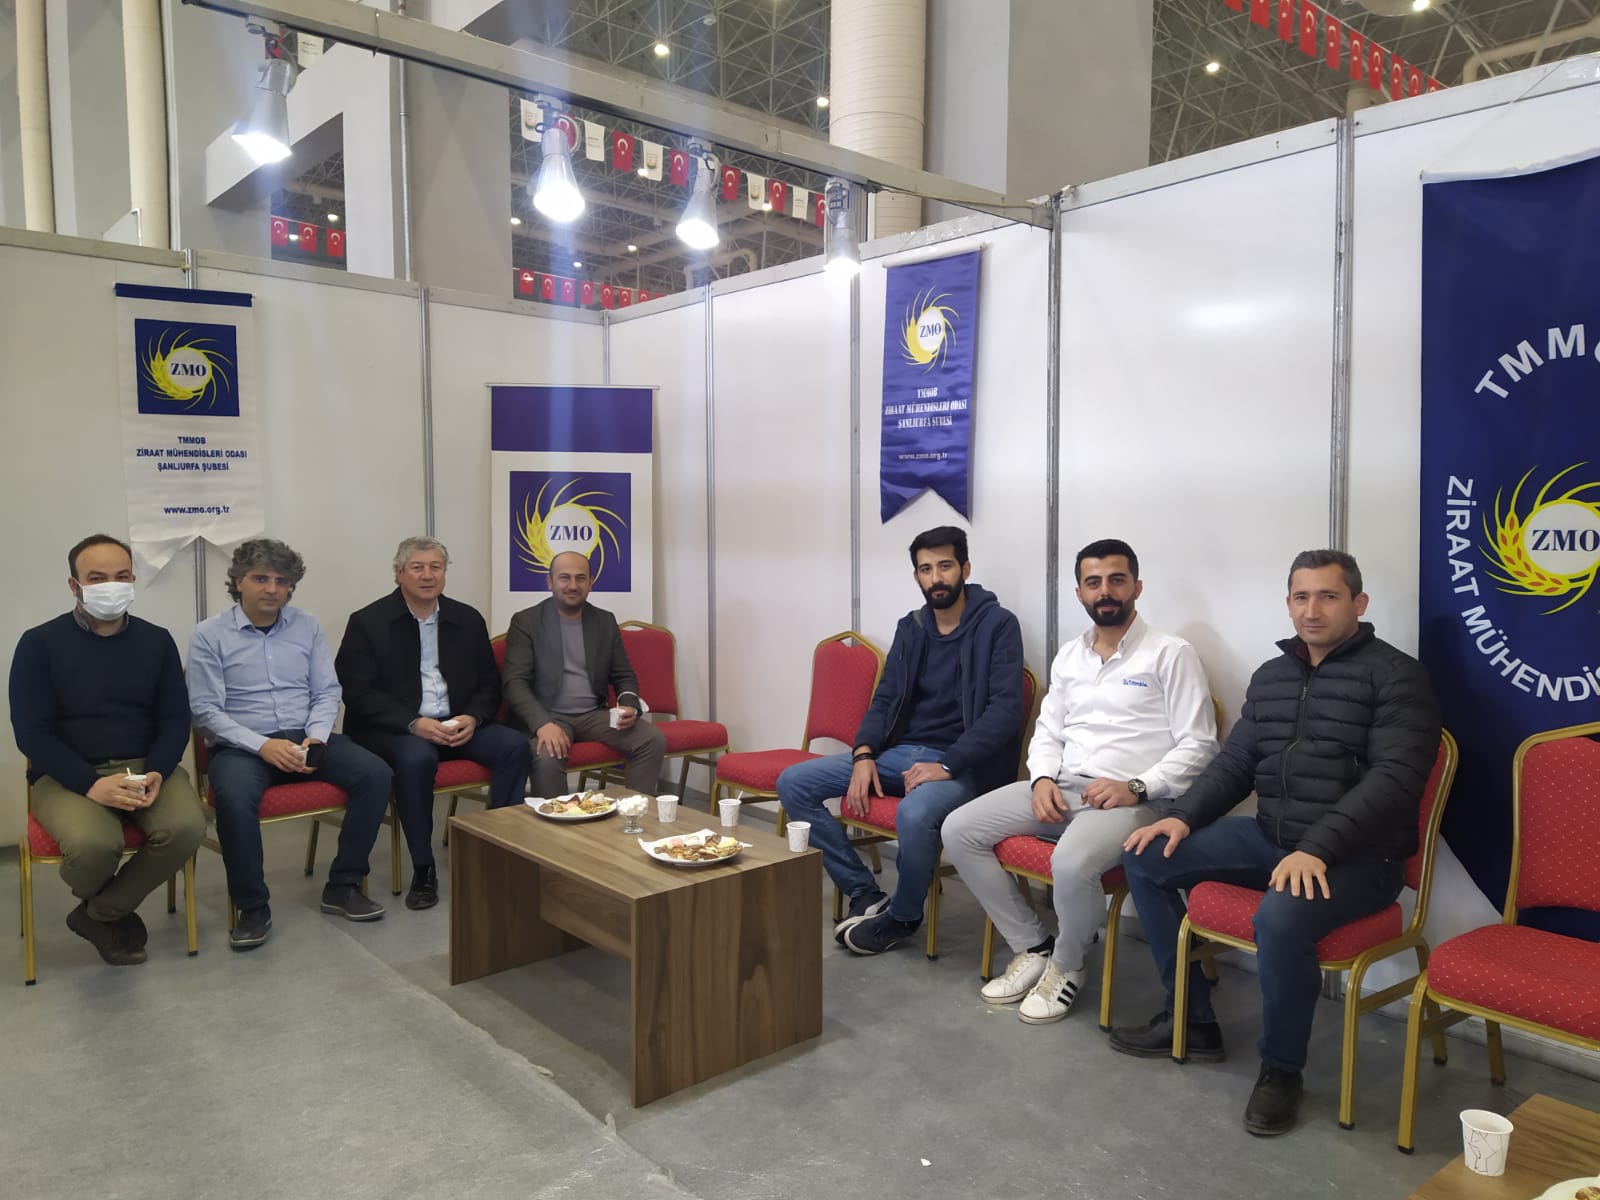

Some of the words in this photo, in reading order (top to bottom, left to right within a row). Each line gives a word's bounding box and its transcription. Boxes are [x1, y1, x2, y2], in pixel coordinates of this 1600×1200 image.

[920, 321, 942, 338] ZMO
[1474, 323, 1600, 399] TMM
[170, 362, 207, 377] ZMO
[177, 436, 206, 445] TMMOB
[136, 448, 164, 457] ZİRAAT
[166, 448, 223, 458] MÜHENDİSLERİ
[225, 450, 247, 458] ODASI
[157, 462, 200, 472] ŞANLIURFA
[202, 460, 229, 472] ŞUBESİ
[163, 504, 230, 515] www.zmo.org.tr
[550, 525, 593, 541] ZMO
[1446, 475, 1480, 597] ZİRAAT
[1531, 529, 1600, 552] ZMO
[1461, 604, 1600, 702] MÜHENDİ
